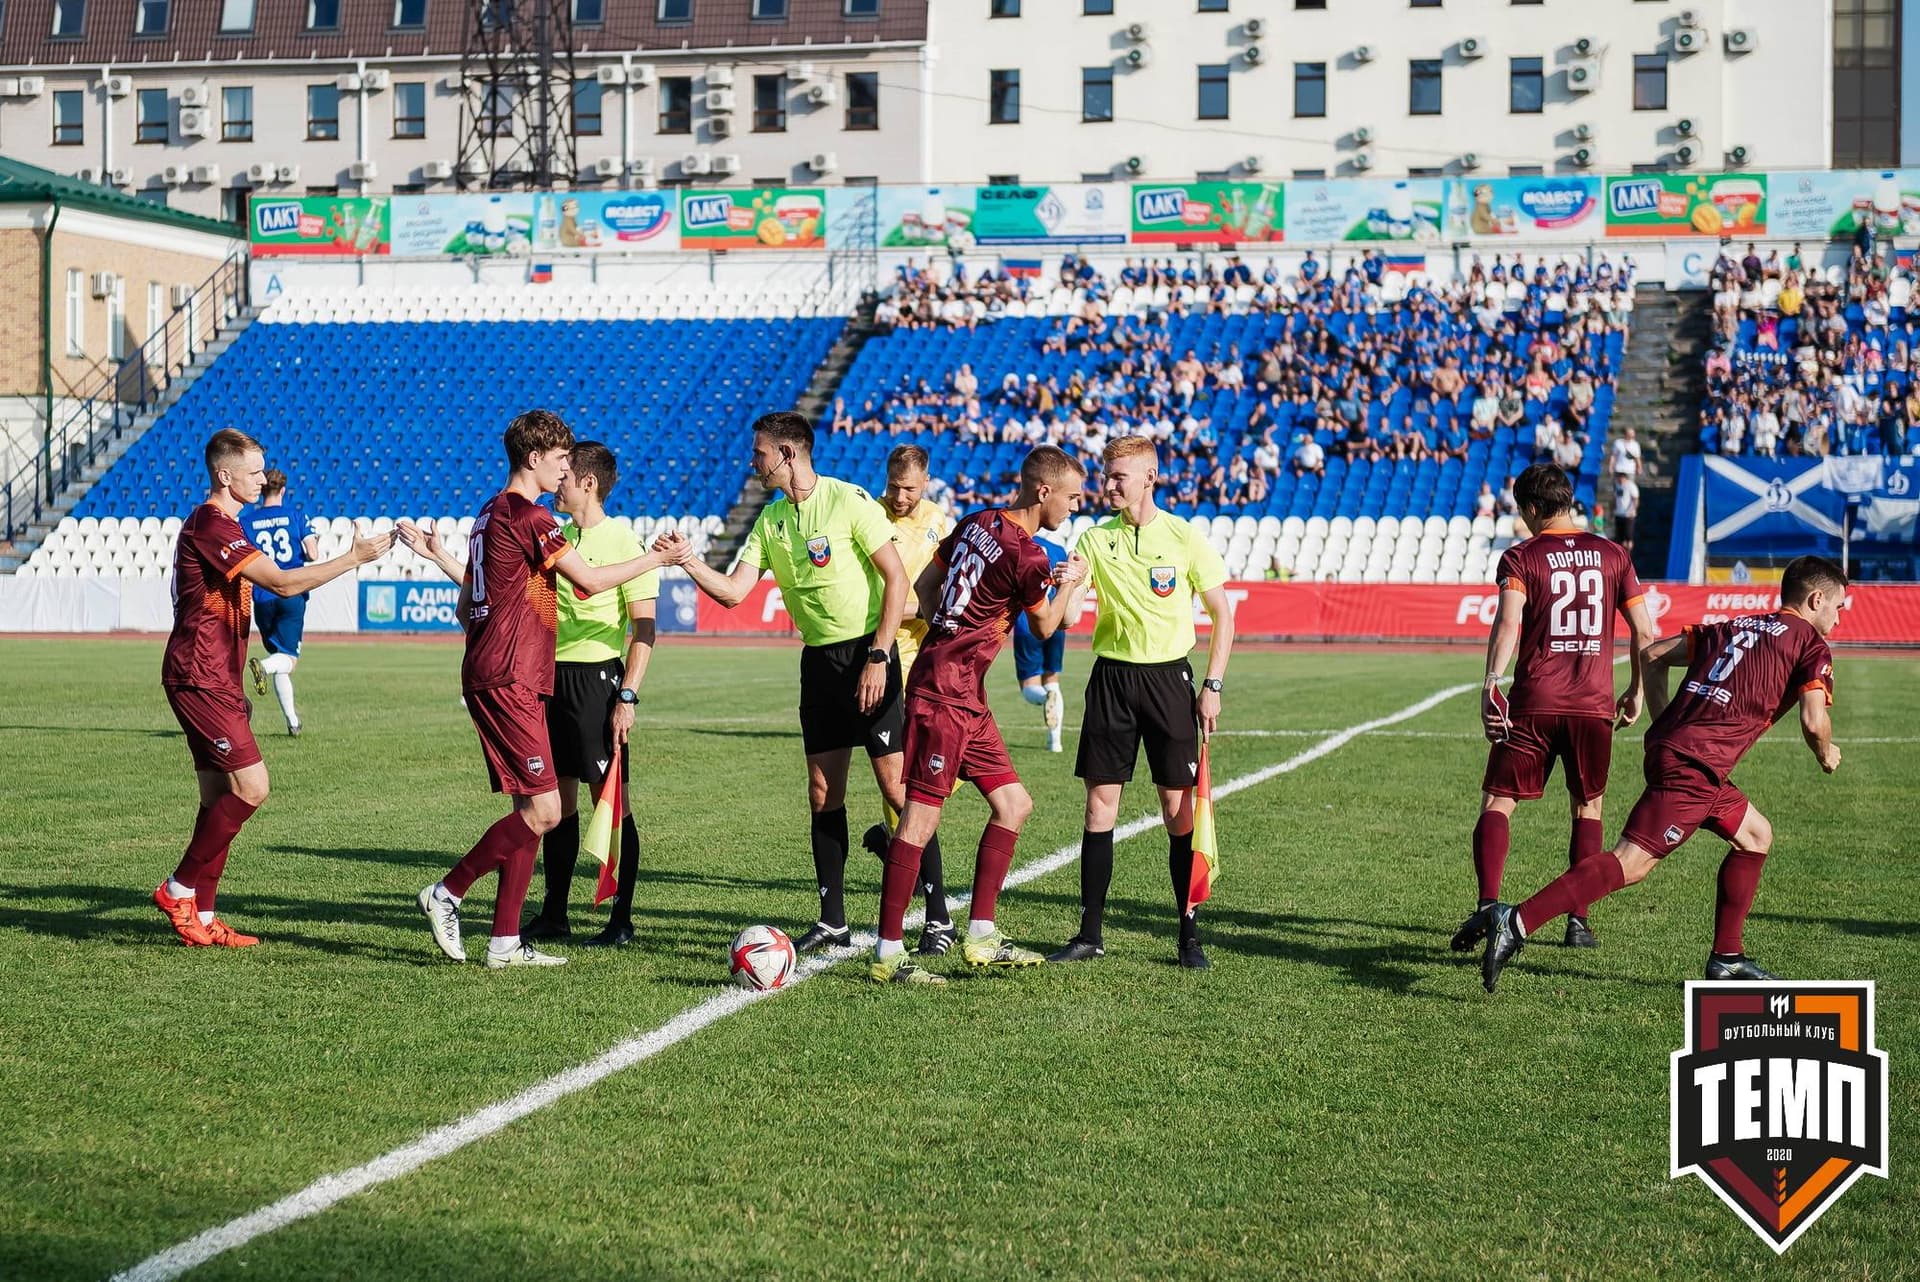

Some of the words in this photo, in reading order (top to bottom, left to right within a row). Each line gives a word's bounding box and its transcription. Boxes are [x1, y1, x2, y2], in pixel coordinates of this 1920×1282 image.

[256, 528, 293, 563] 33
[1546, 550, 1601, 570] ВОРОНА
[1551, 569, 1604, 637] 23
[1707, 593, 1771, 611] КУБОК
[401, 605, 457, 625] ГОРО
[1550, 640, 1601, 653] SEUS
